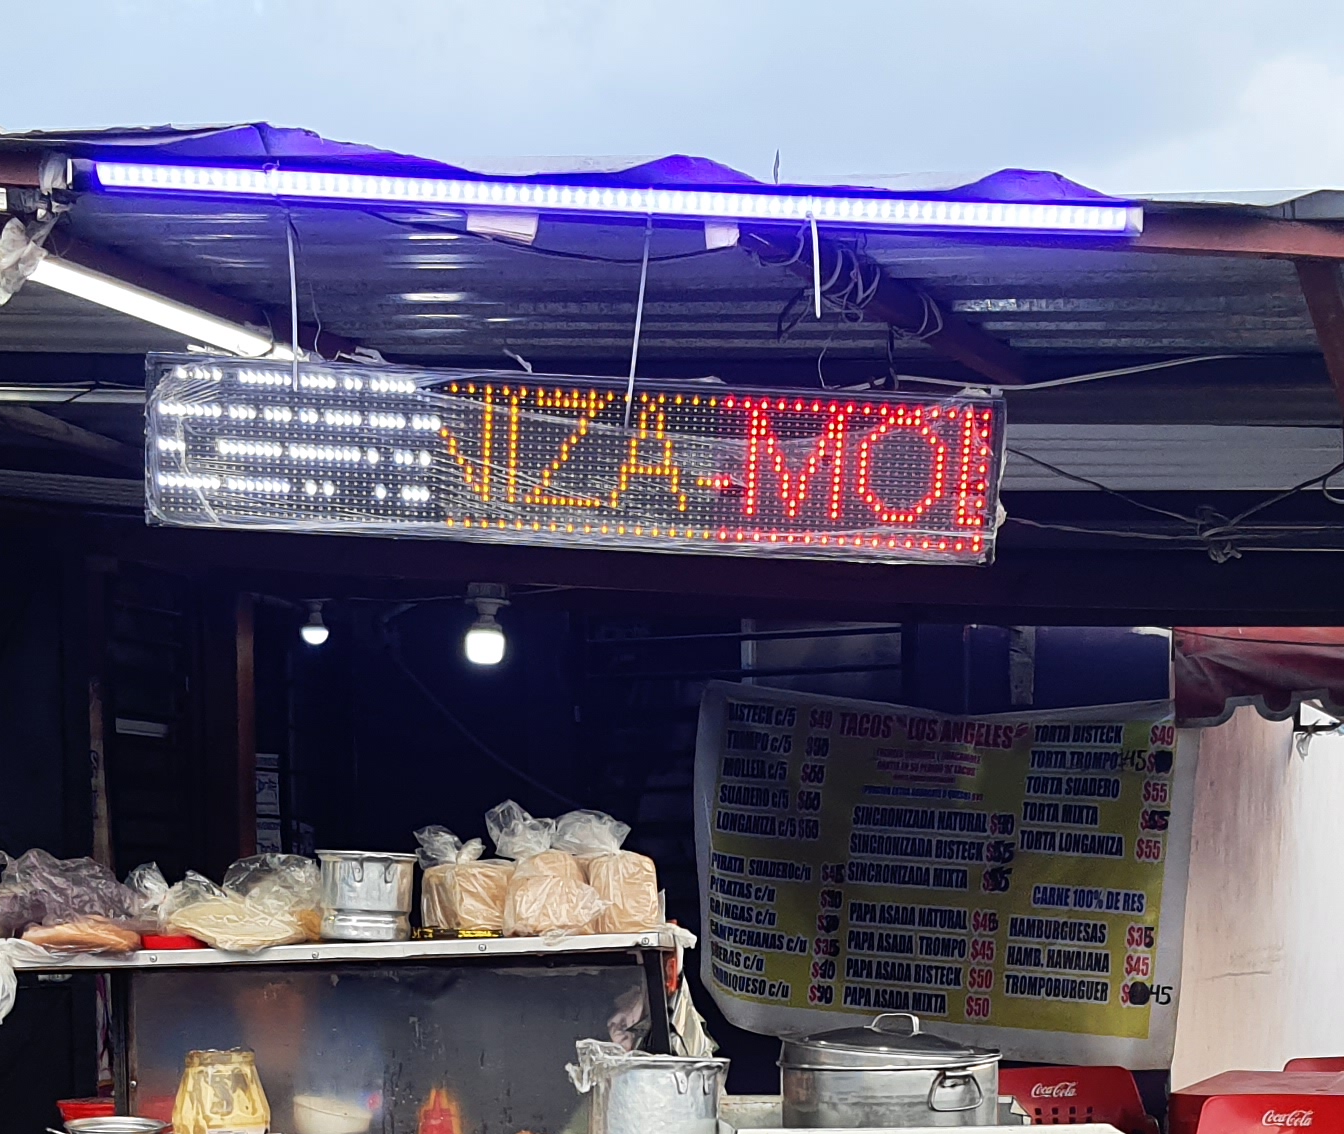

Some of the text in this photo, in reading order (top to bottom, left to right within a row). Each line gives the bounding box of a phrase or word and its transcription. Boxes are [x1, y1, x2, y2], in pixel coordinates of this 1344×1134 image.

[840, 712, 893, 738] TACOS
[1035, 724, 1174, 746] TORTA BISTECK $49
[1031, 750, 1066, 769] TORTA
[1069, 751, 1118, 770] TROMPO
[720, 784, 769, 807] SUADERO
[1027, 776, 1167, 803] TORTA SUADERO $55
[717, 810, 776, 836] LONGANIZA
[853, 805, 935, 830] SINCRONIZADA
[937, 811, 987, 833] NATURAL
[1023, 802, 1098, 826] TORTA MIXTA
[850, 832, 932, 858] SINCRONIZADA
[935, 839, 985, 862] BISTECK
[1020, 830, 1161, 860] TORTA LONGANIZA $55
[848, 861, 930, 887] SINCRONIZADA
[933, 868, 968, 889] MIXTA
[755, 886, 775, 902] c/u
[1033, 885, 1144, 913] CARNE 100% DE RES
[756, 909, 776, 926] c/u
[850, 902, 967, 930] PAPA ASADA NATURAL
[1009, 917, 1106, 944] HAMBURGUESAS
[787, 937, 807, 952] c/u
[848, 930, 994, 961] PAPA ASADA TROMPO $45
[846, 958, 993, 989] PAPA ASADA BISTECK $50
[1007, 945, 1149, 976] HAMB. HAWAIANA $45
[768, 981, 789, 998] c/u
[1005, 974, 1109, 1002] TROMPOBURGUER
[844, 986, 871, 1007] PAPA
[873, 989, 909, 1011] ASADA
[912, 992, 946, 1014] MIXTA
[966, 995, 990, 1018] $50
